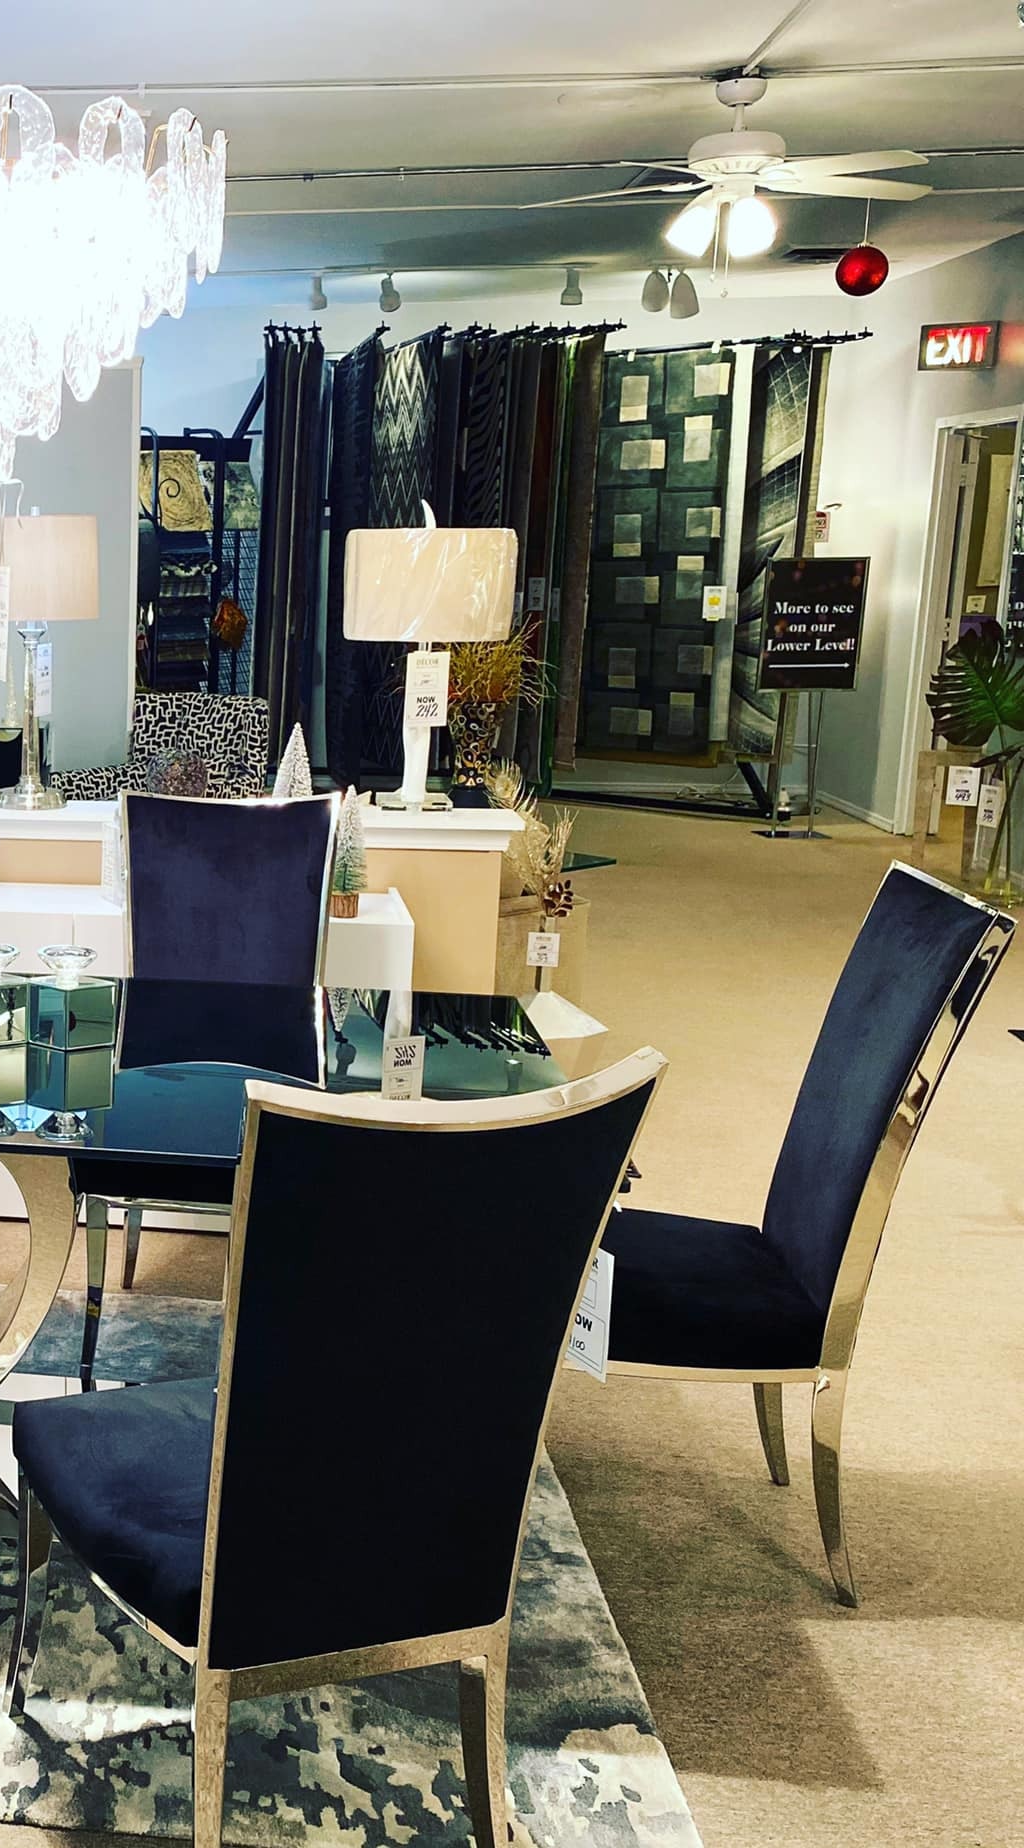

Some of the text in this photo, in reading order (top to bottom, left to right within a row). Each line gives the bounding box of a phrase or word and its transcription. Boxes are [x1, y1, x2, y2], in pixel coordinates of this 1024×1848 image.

[925, 326, 992, 366] EXIT
[774, 601, 855, 615] More to see
[788, 623, 836, 633] on our
[766, 638, 856, 652] Lower Level!
[416, 695, 436, 704] NOW
[574, 1312, 593, 1332] OW
